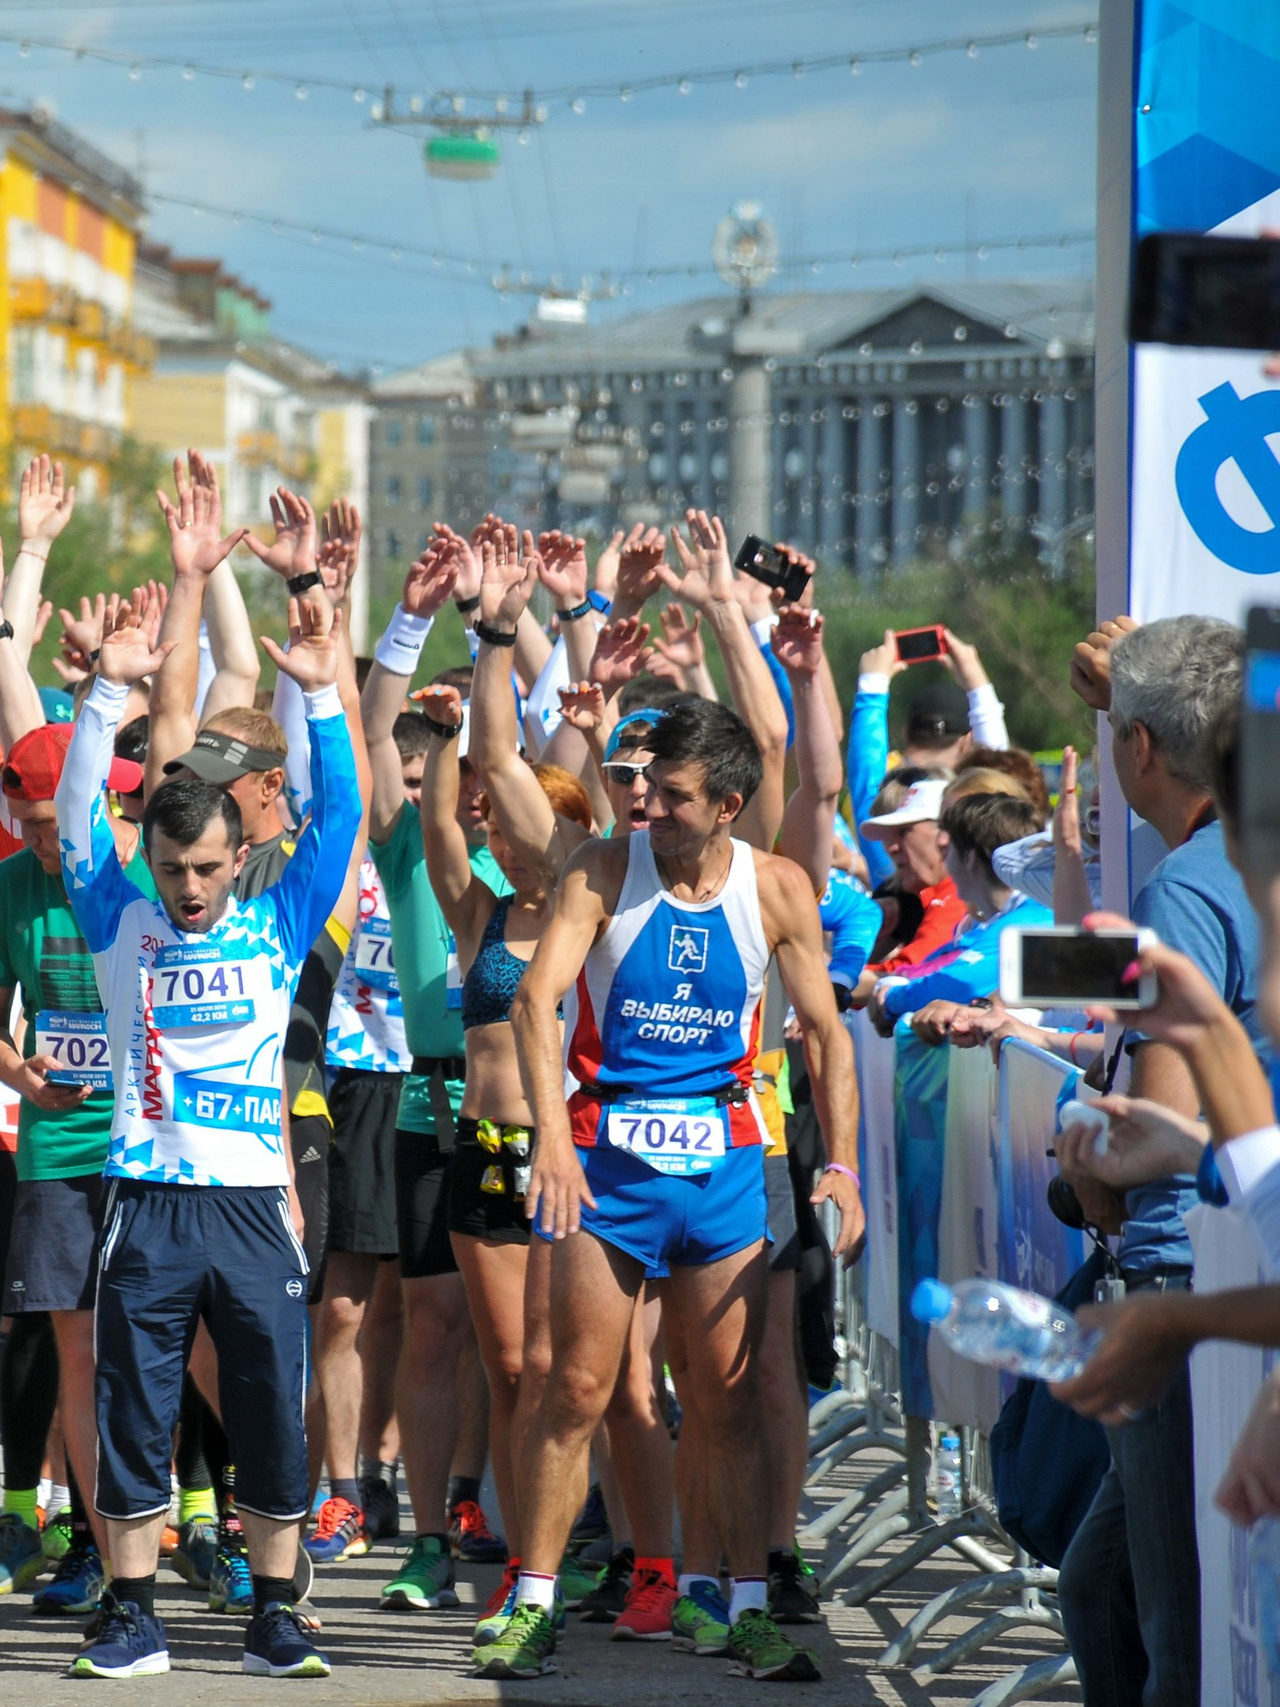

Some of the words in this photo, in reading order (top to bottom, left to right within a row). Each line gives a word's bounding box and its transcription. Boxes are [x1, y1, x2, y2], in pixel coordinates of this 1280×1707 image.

[161, 966, 244, 1002] 7041
[672, 983, 693, 1000] Я
[191, 1012, 211, 1023] 42,2
[620, 999, 734, 1028] ВЫБИРАЮ
[637, 1022, 713, 1046] СПОРТ
[45, 1036, 109, 1067] 702
[196, 1090, 233, 1121] 67
[620, 1119, 712, 1151] 7042
